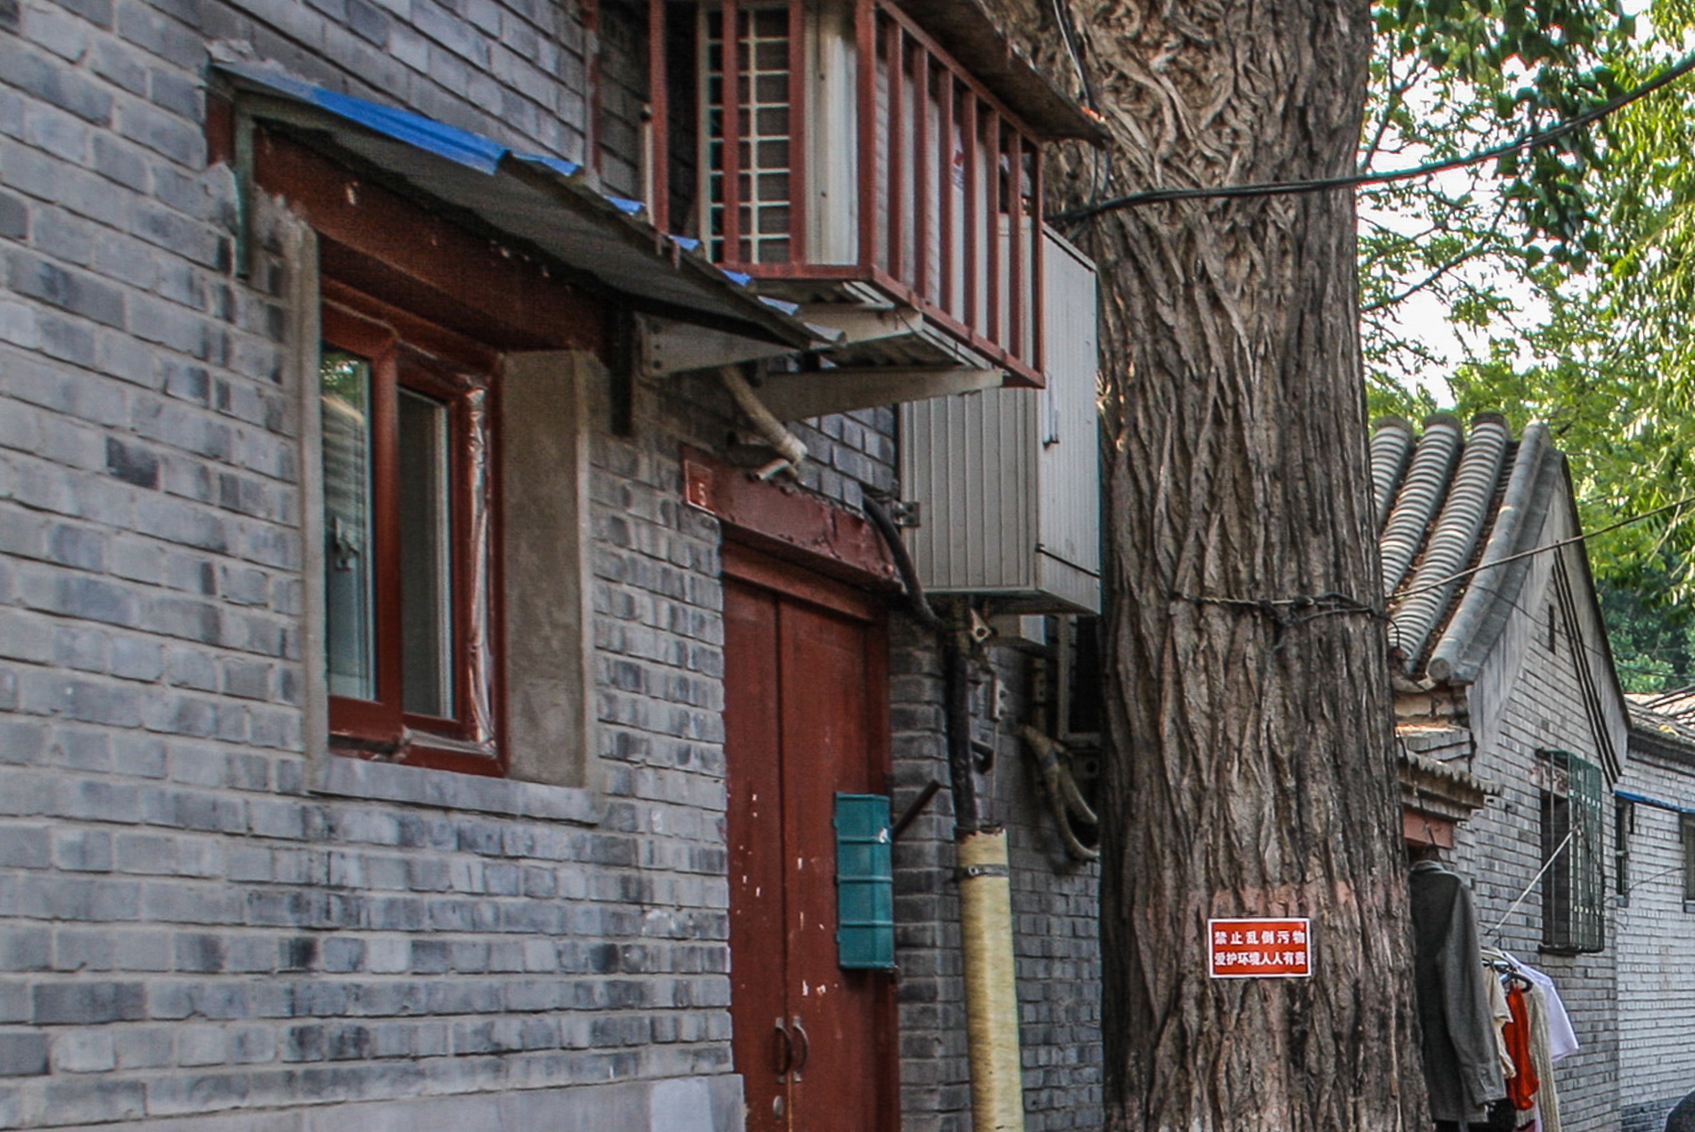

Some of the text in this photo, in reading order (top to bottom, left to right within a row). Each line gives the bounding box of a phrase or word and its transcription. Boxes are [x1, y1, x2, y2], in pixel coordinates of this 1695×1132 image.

[1214, 931, 1305, 944] 禁止乱倒污物
[1214, 951, 1306, 966] 爱护环境人人有责
